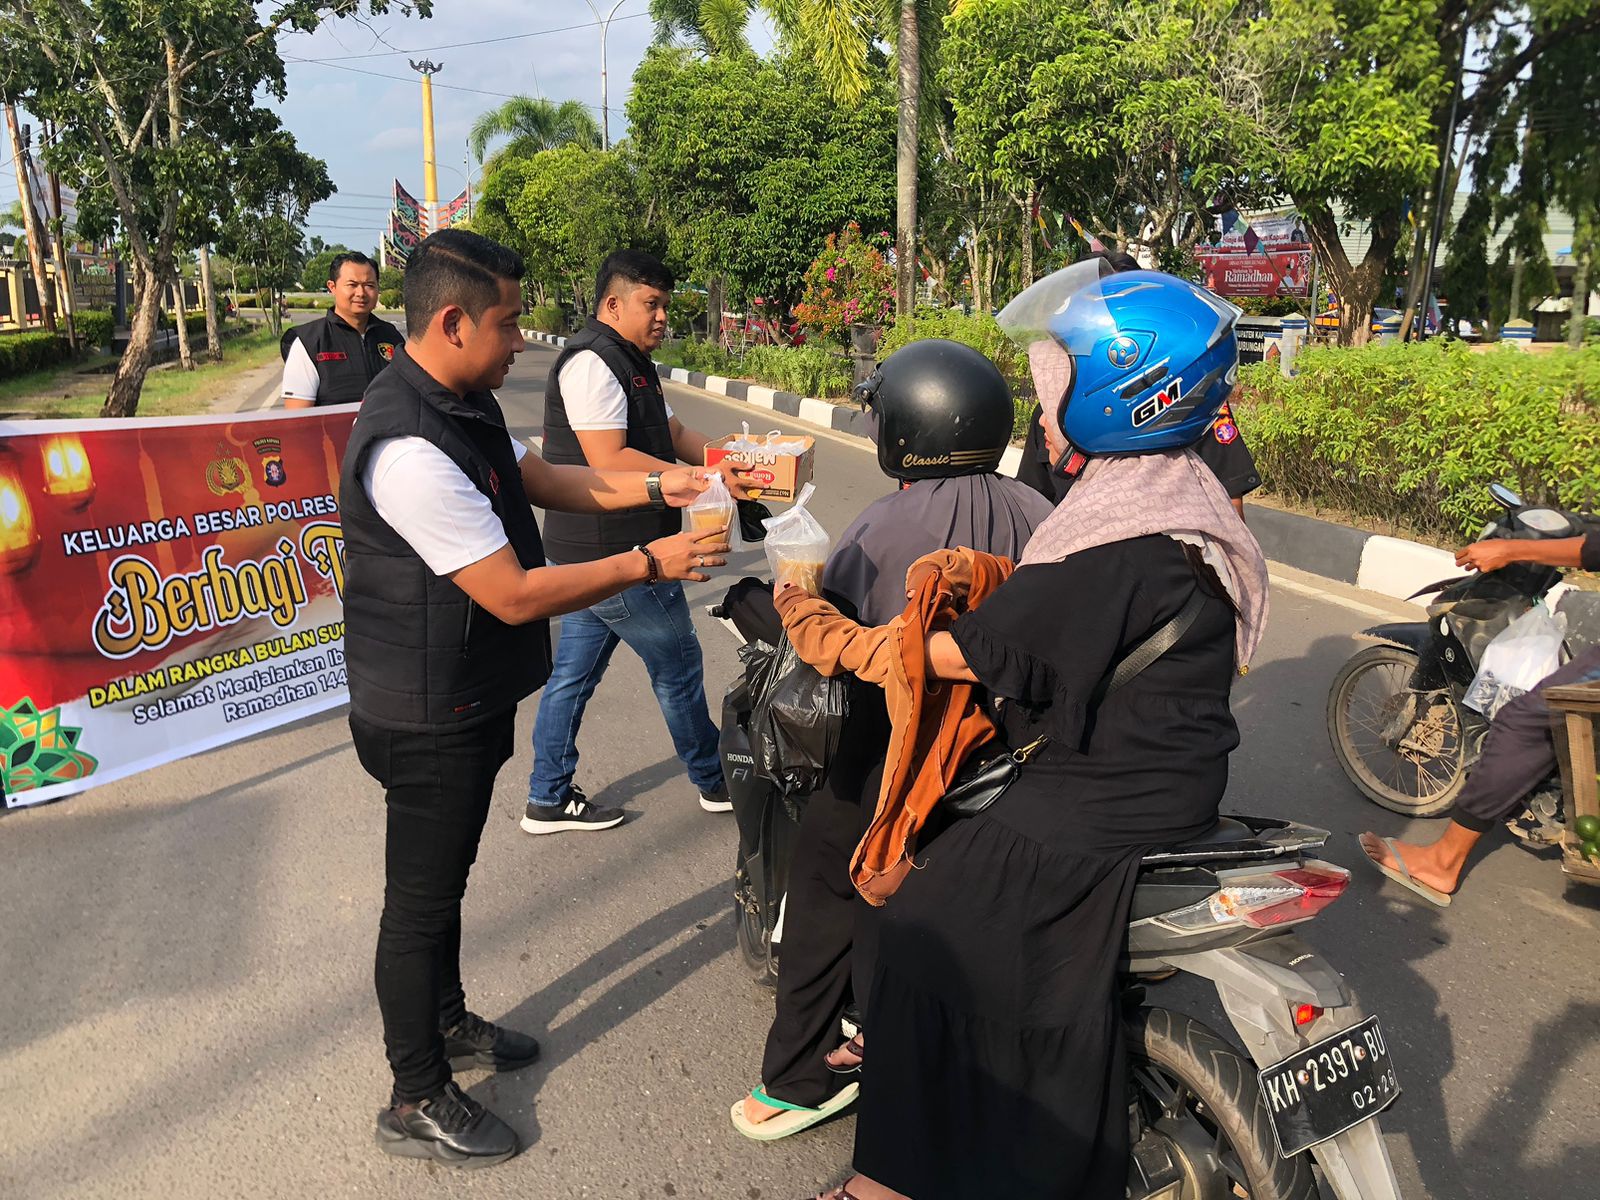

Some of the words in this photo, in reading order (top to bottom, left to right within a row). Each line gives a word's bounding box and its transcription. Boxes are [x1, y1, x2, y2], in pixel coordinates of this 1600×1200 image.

[1224, 270, 1273, 282] Ramadhan
[1132, 377, 1184, 428] GM
[902, 453, 950, 468] Classic
[63, 516, 190, 555] KELUARGA
[194, 506, 262, 534] BESAR
[265, 495, 338, 522] POLRES
[93, 538, 306, 658] Berbagi
[301, 522, 345, 602] T
[89, 669, 167, 707] DALAM
[168, 648, 253, 686] RANGKA
[254, 630, 317, 662] BULAN
[134, 686, 214, 724] Selamat
[217, 657, 325, 700] Menjalankan
[223, 681, 318, 722] Ramadhan
[727, 753, 754, 764] HONDA
[1267, 1070, 1300, 1112] KH
[1306, 1039, 1359, 1091] 2397
[1364, 1024, 1386, 1062] BU
